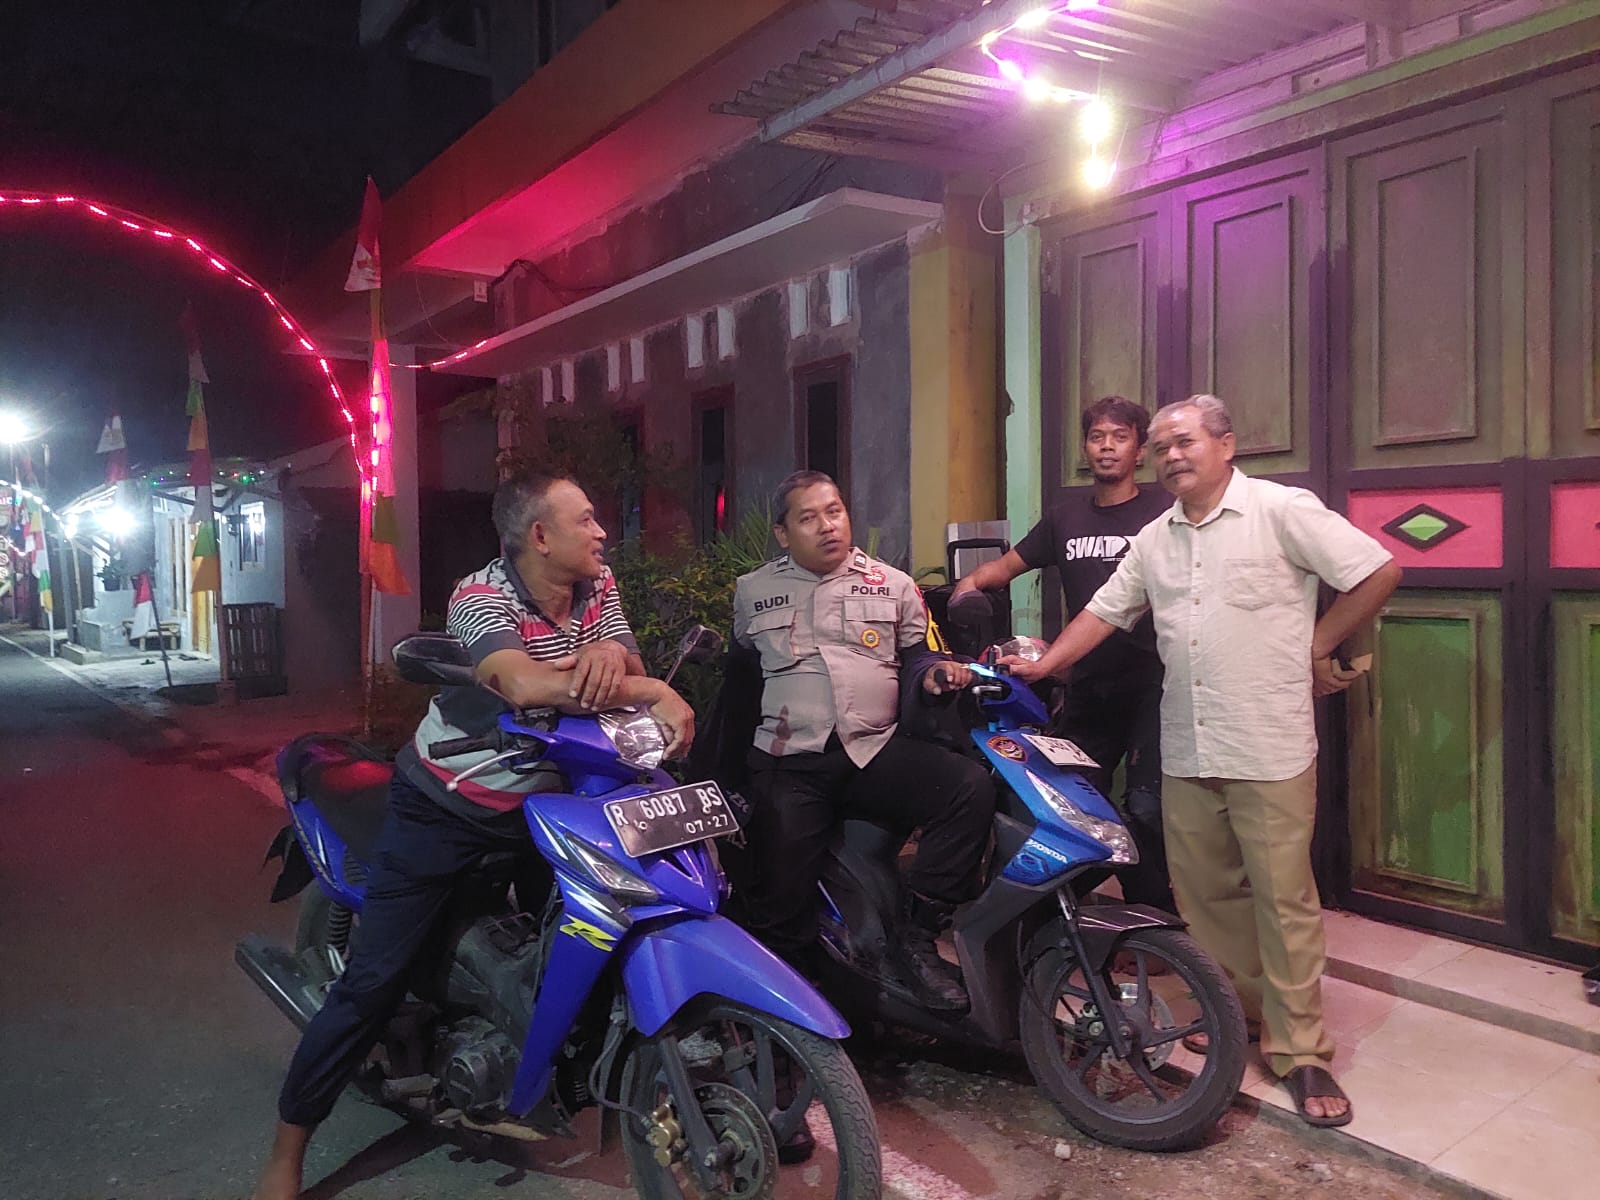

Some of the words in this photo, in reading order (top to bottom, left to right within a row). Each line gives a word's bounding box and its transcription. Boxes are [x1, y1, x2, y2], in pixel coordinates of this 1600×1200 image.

[851, 586, 890, 597] POLRI
[754, 595, 790, 612] BUDI
[610, 805, 628, 825] R
[640, 793, 687, 819] 6087
